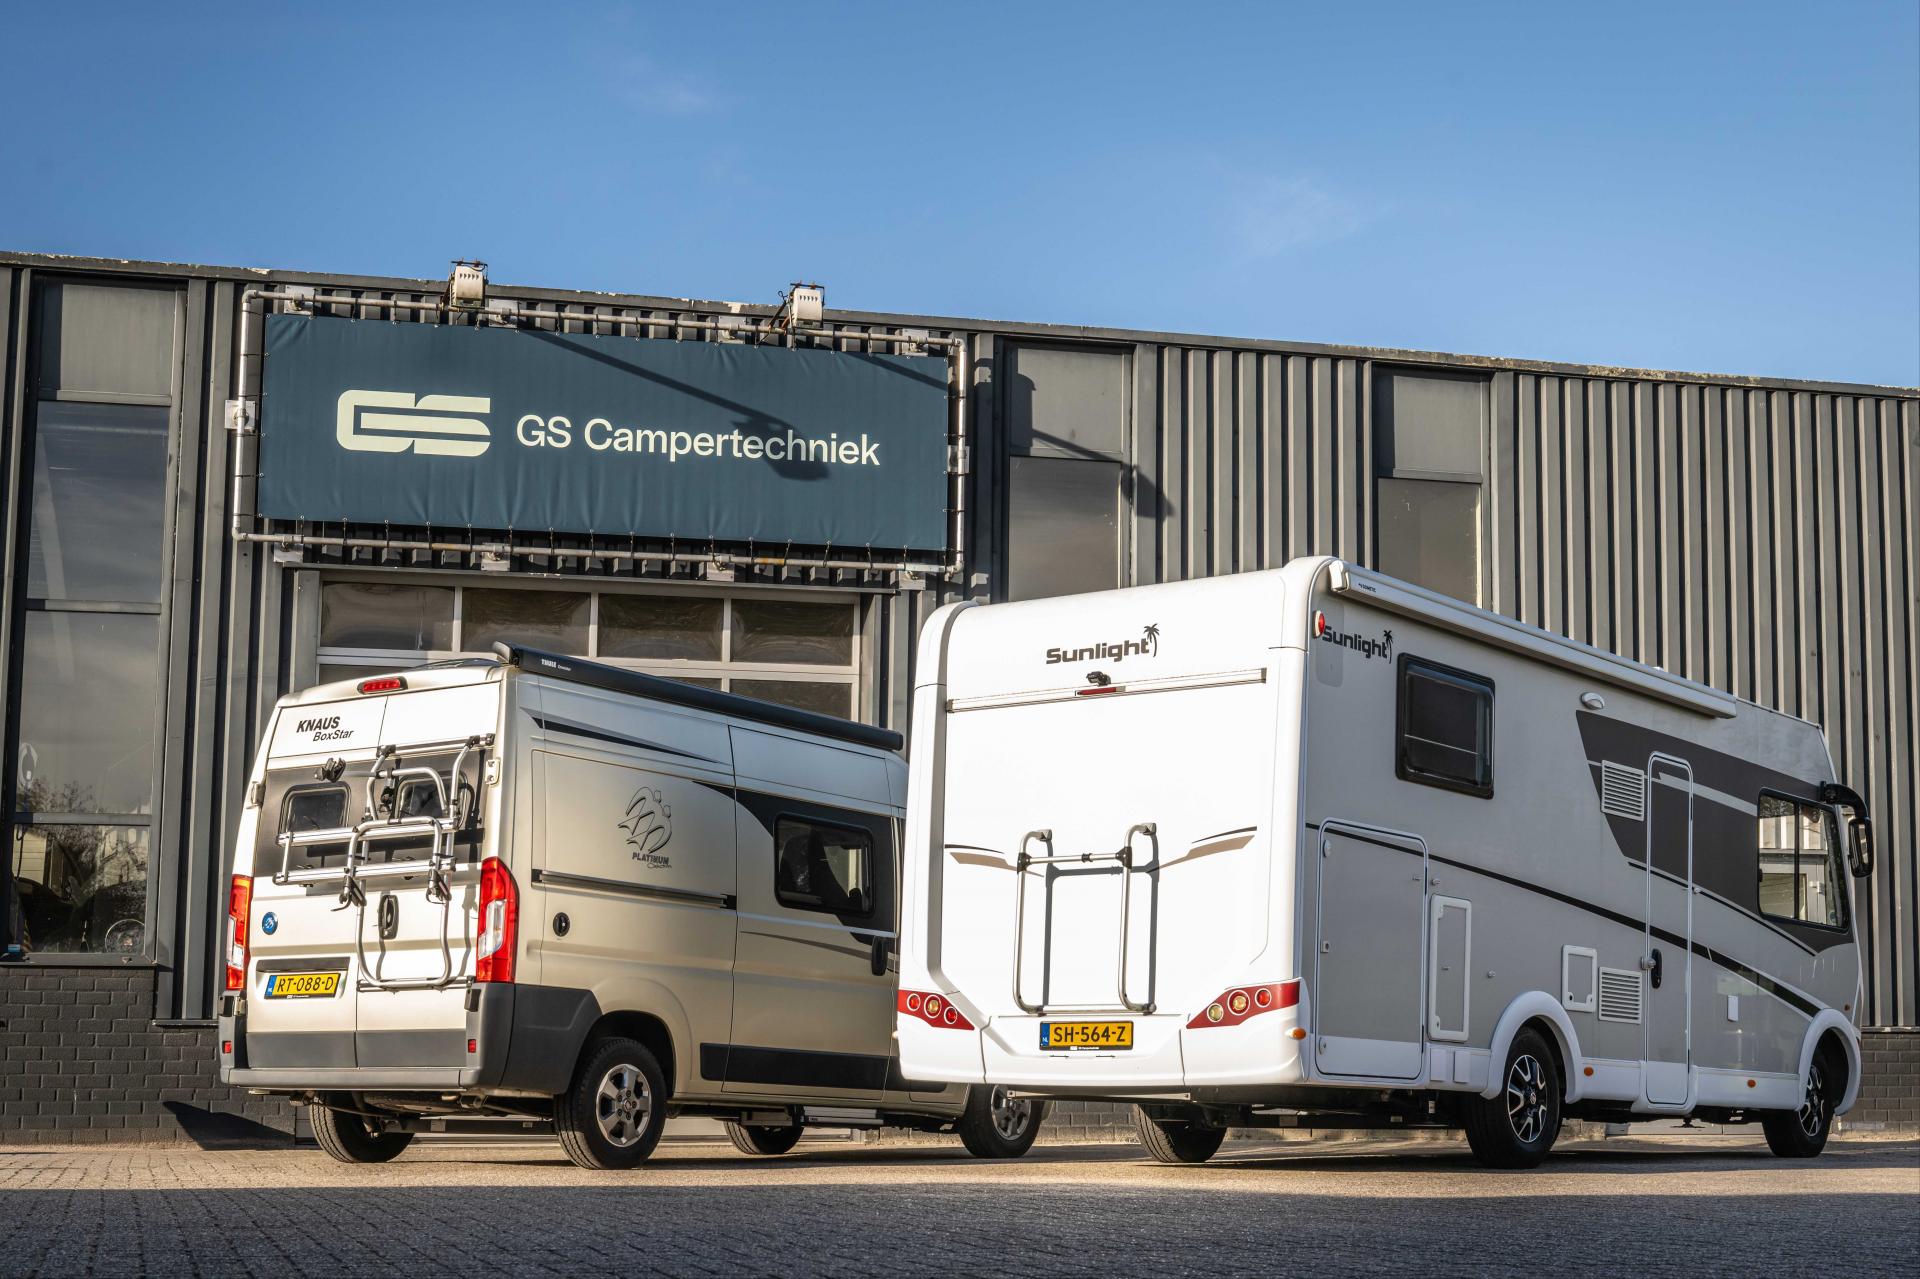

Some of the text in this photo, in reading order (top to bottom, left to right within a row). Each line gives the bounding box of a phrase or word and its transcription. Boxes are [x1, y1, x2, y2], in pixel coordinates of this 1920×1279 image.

[516, 414, 881, 467] GS Campertechniek
[1322, 625, 1387, 659] Sunlight
[1046, 638, 1150, 664] Sunlight
[296, 716, 341, 733] KNAUS
[313, 729, 354, 742] BoxStar
[632, 852, 669, 864] PLATINUM
[277, 976, 334, 992] RT-088-D
[1053, 1026, 1126, 1042] SH-564-Z
